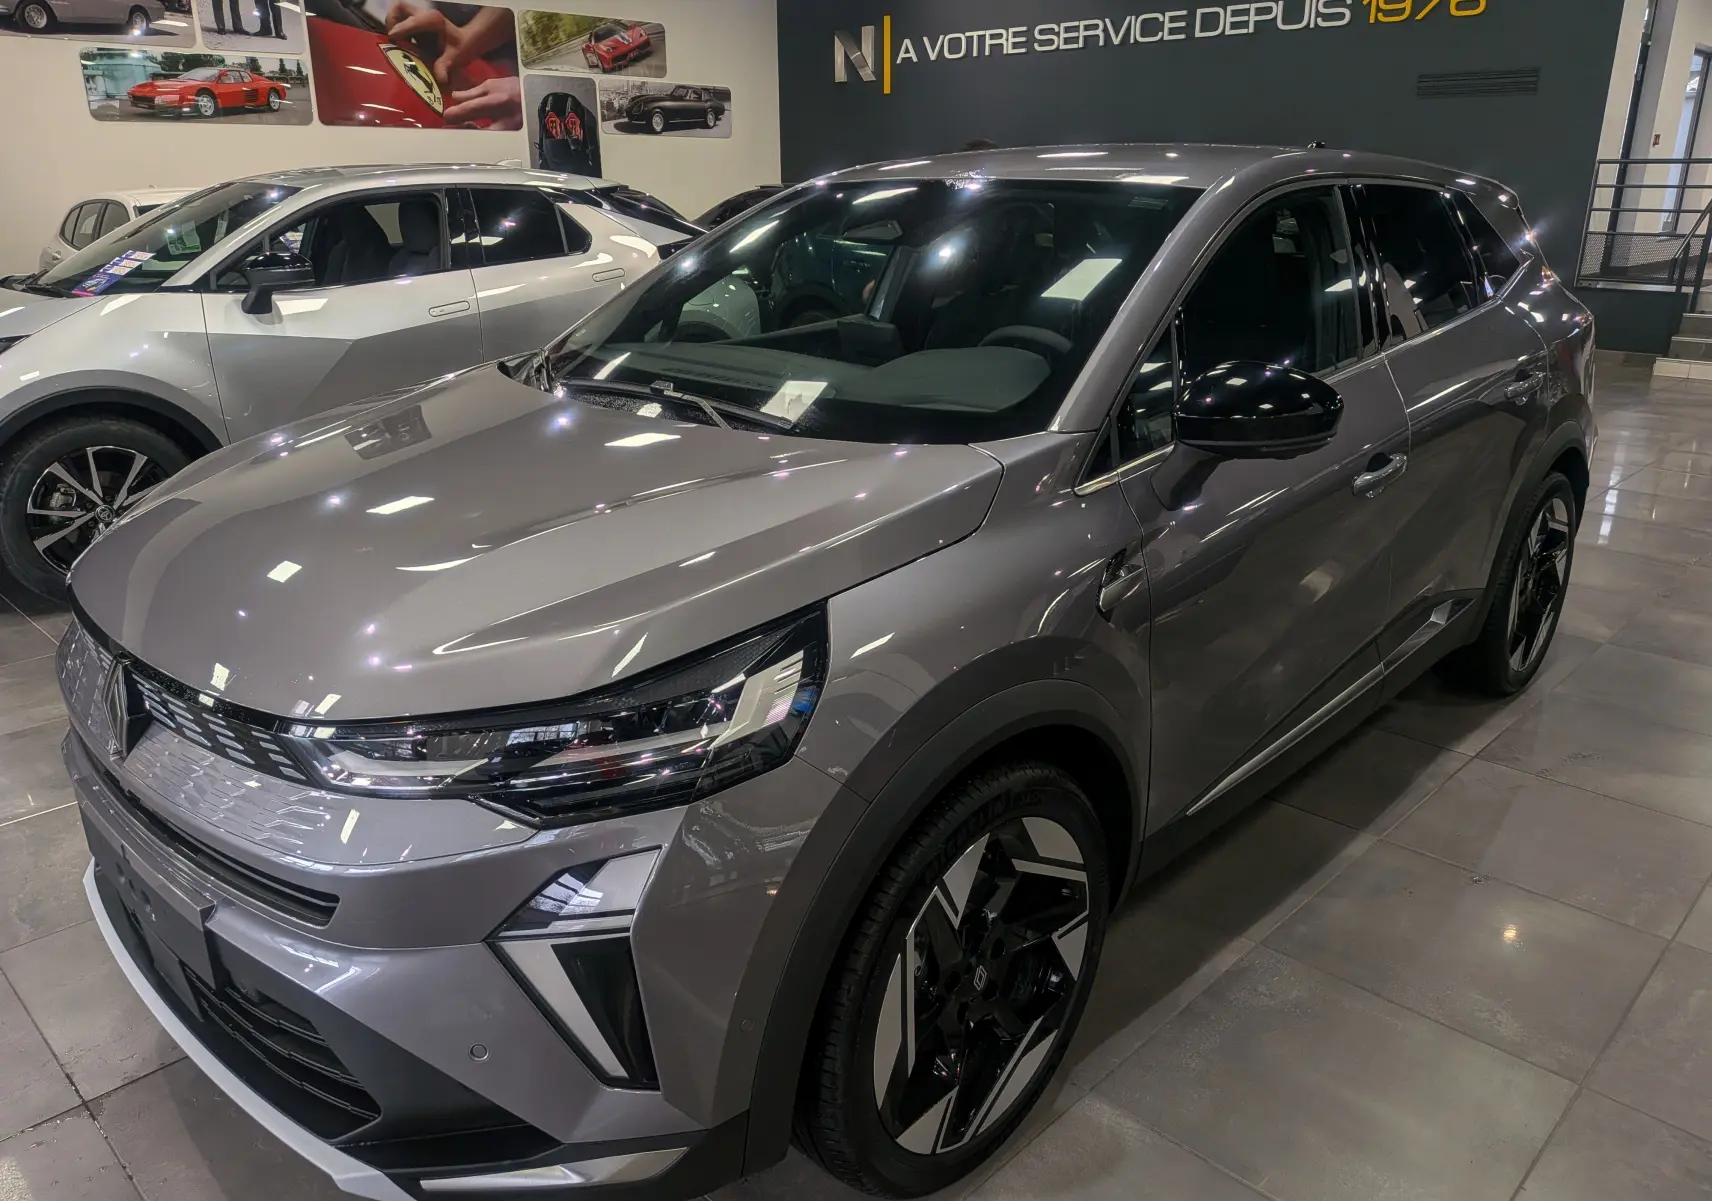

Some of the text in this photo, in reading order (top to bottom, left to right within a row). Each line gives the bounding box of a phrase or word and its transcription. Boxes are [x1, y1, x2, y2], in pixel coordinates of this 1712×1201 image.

[896, 38, 918, 64] A
[922, 26, 1029, 61] VOTRE
[1033, 10, 1188, 51] SERVICE
[1194, 0, 1352, 38] DEPUIS
